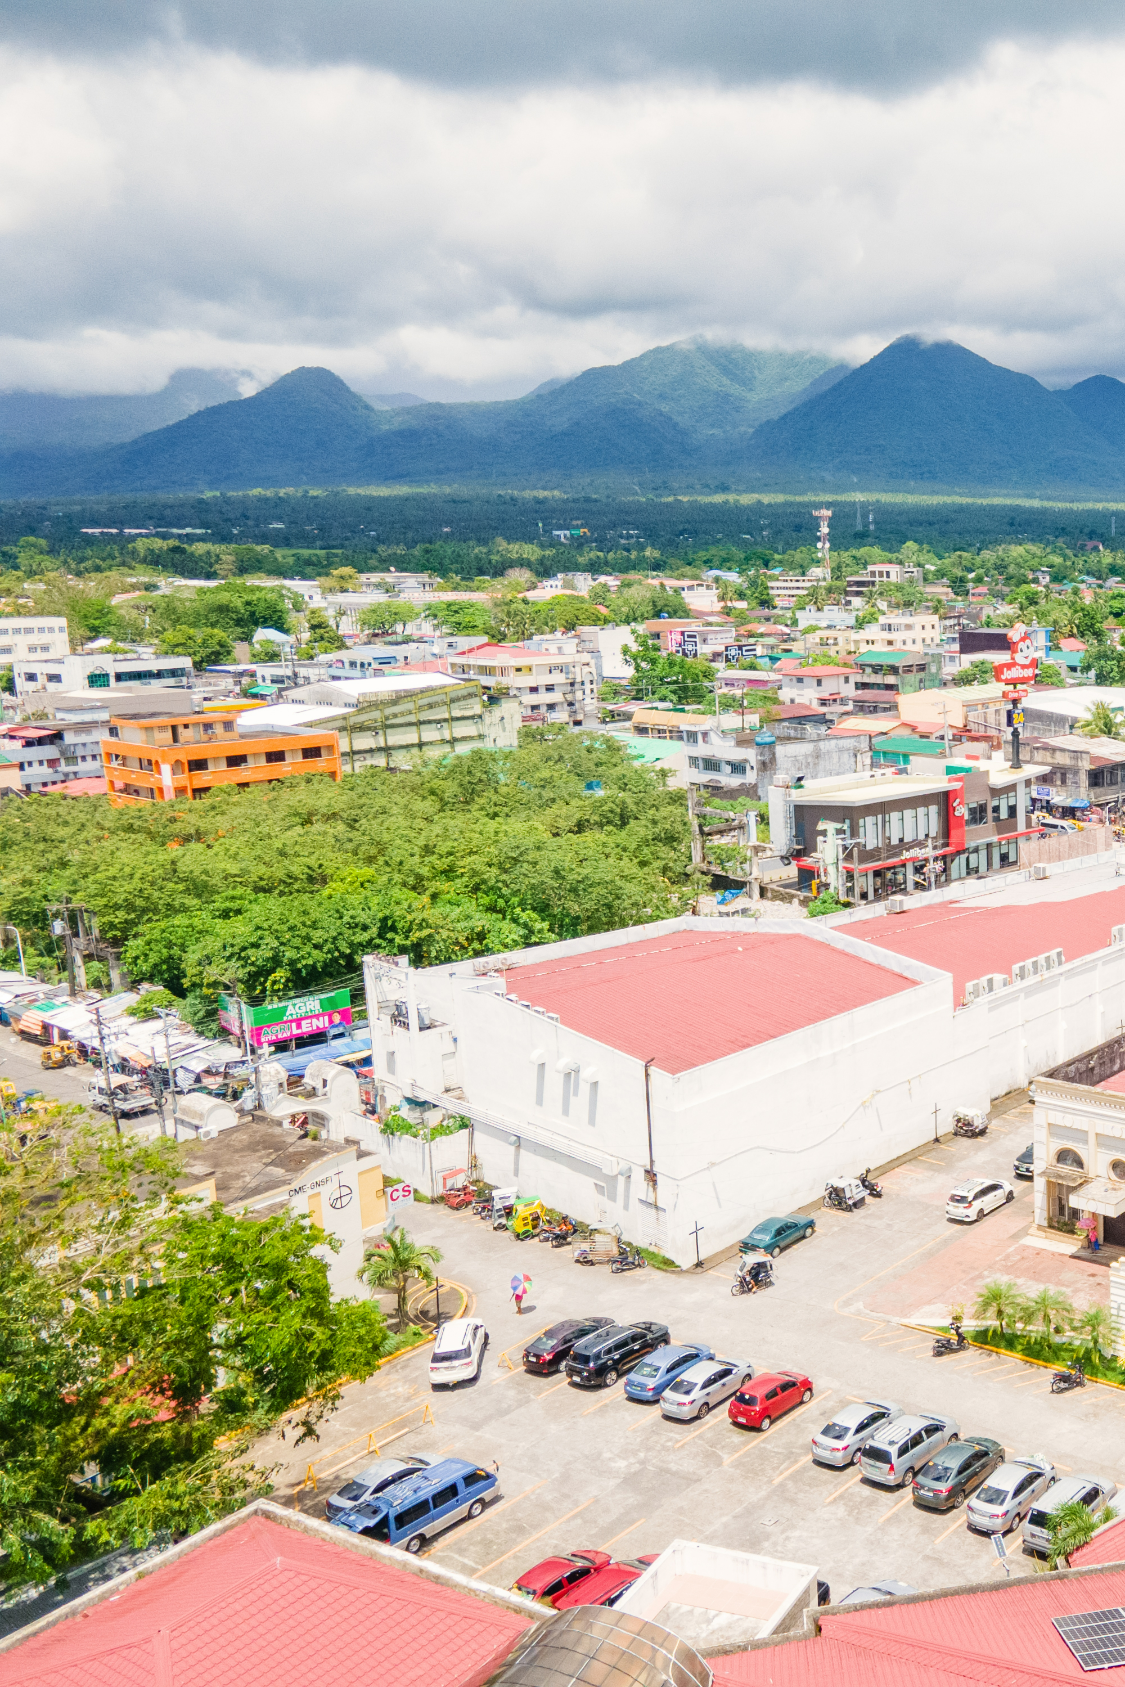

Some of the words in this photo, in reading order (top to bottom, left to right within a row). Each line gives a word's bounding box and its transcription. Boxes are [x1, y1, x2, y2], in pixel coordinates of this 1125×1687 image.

[1001, 666, 1033, 679] Jollibee
[1013, 712, 1025, 724] 24
[286, 1000, 320, 1016] AGRI
[262, 1023, 290, 1036] AGRI
[291, 1016, 329, 1035] LENI
[389, 1184, 412, 1202] CS
